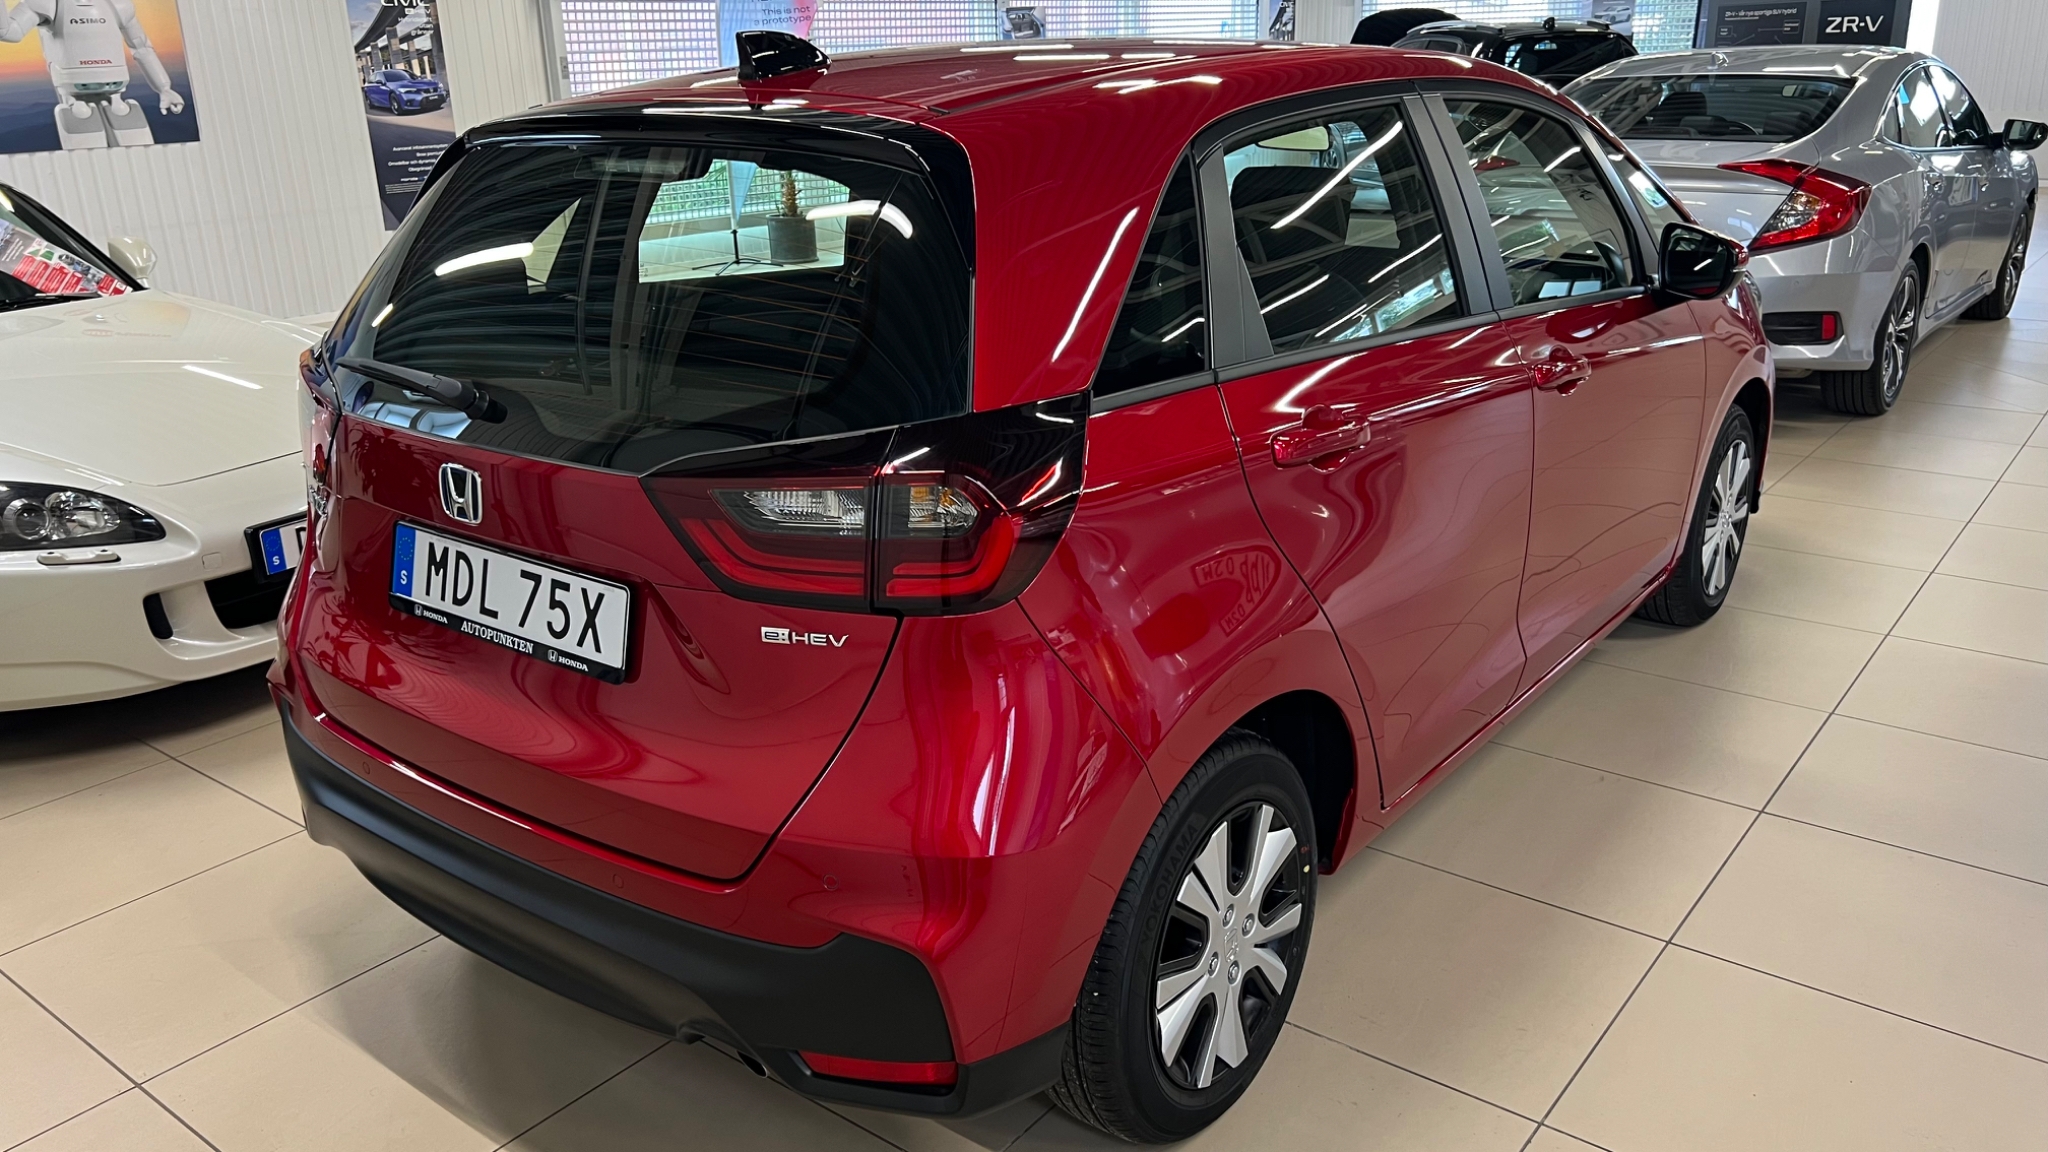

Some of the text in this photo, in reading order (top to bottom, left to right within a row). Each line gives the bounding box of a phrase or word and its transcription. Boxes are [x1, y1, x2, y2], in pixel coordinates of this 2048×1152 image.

[762, 5, 811, 16] This is not
[762, 15, 812, 26] prototype
[1825, 15, 1884, 33] ZR-V
[273, 555, 280, 565] S
[400, 570, 408, 585] S
[426, 542, 605, 654] MDL 75X
[423, 610, 448, 624] HONDA
[461, 620, 534, 655] AUTOPUNKTEN
[761, 626, 849, 648] e:HEV
[558, 655, 589, 672] HONDA
[1141, 823, 1199, 945] YOKOHAMA
